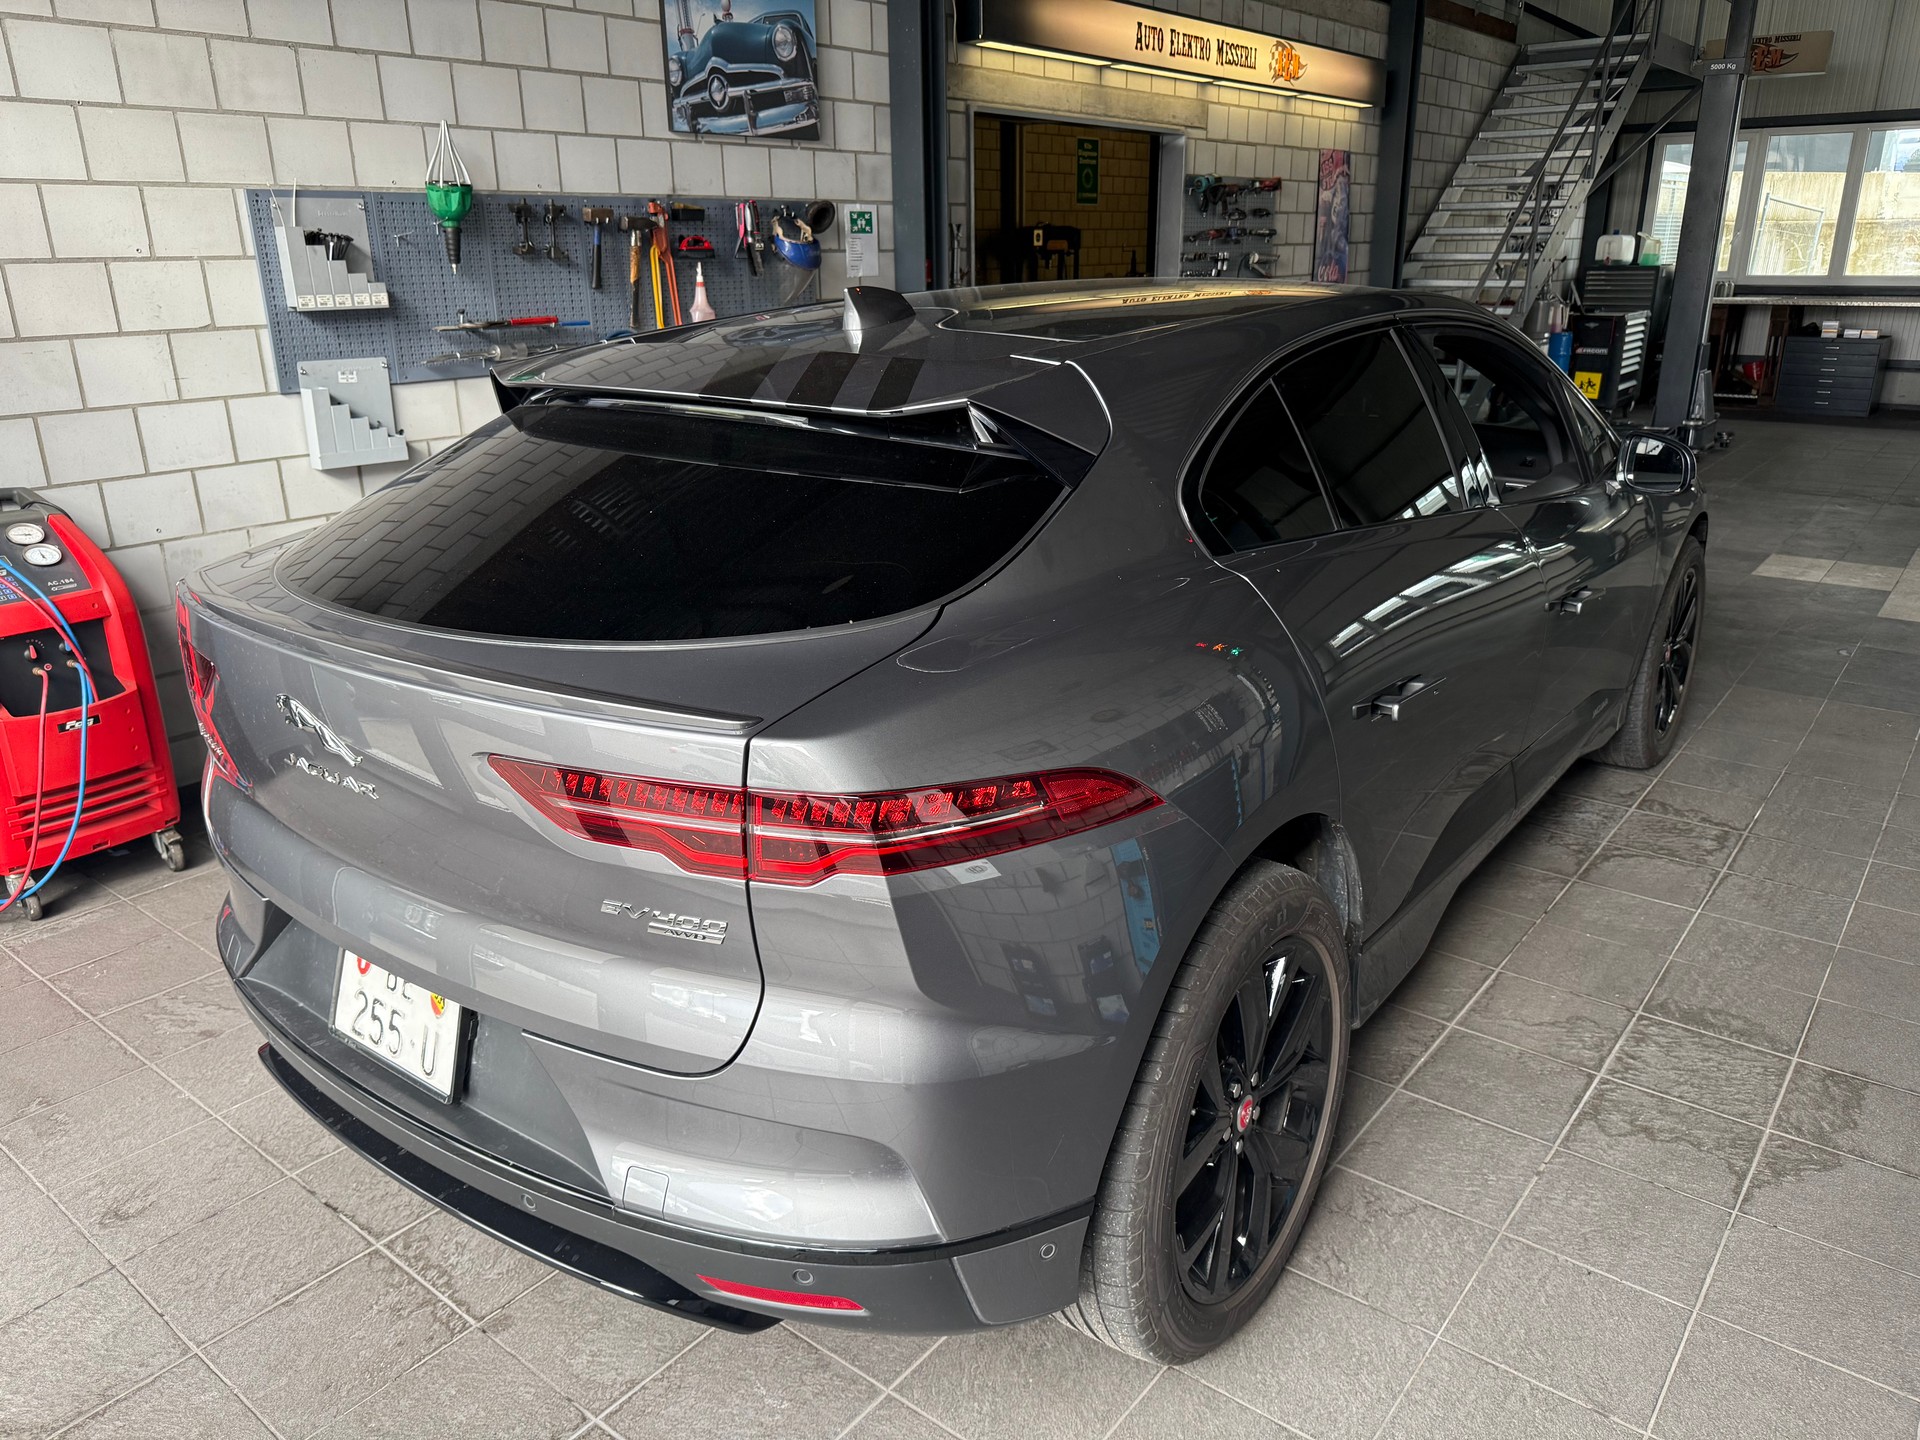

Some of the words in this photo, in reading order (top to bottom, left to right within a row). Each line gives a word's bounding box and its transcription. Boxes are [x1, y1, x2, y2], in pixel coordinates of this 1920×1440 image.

[1135, 22, 1164, 53] AUTO
[1169, 28, 1211, 62] ELEKTRO
[1215, 39, 1257, 70] MESSERLI
[1752, 36, 1773, 44] LEKTRO
[1727, 62, 1737, 70] Kg
[283, 752, 380, 800] JAGUAR
[664, 928, 707, 941] AWD
[352, 989, 405, 1056] 255
